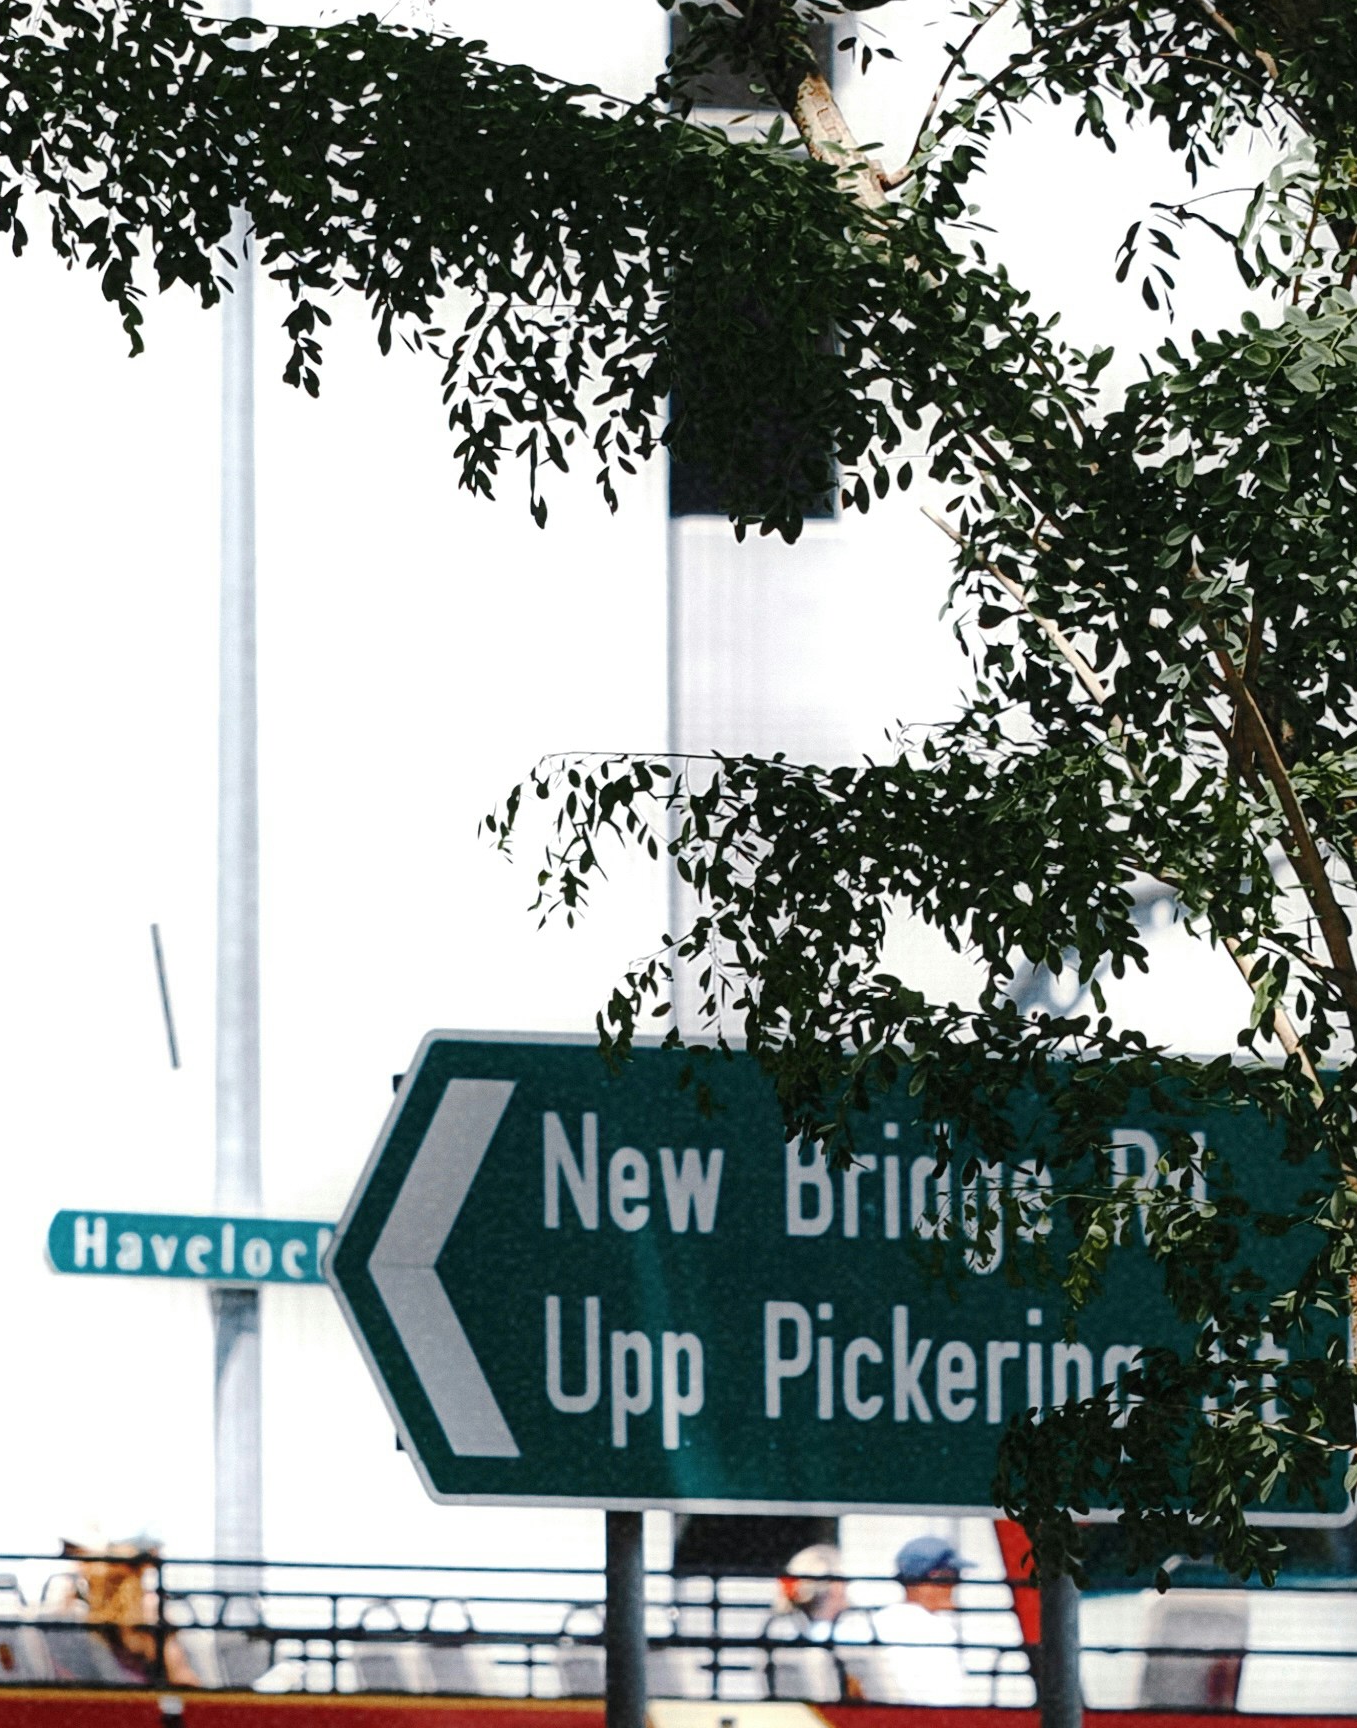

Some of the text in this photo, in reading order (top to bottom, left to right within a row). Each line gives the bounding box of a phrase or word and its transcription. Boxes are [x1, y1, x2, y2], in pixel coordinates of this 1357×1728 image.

[544, 1111, 724, 1234] New
[784, 1121, 1054, 1275] Bridge
[545, 1294, 705, 1450] Upp
